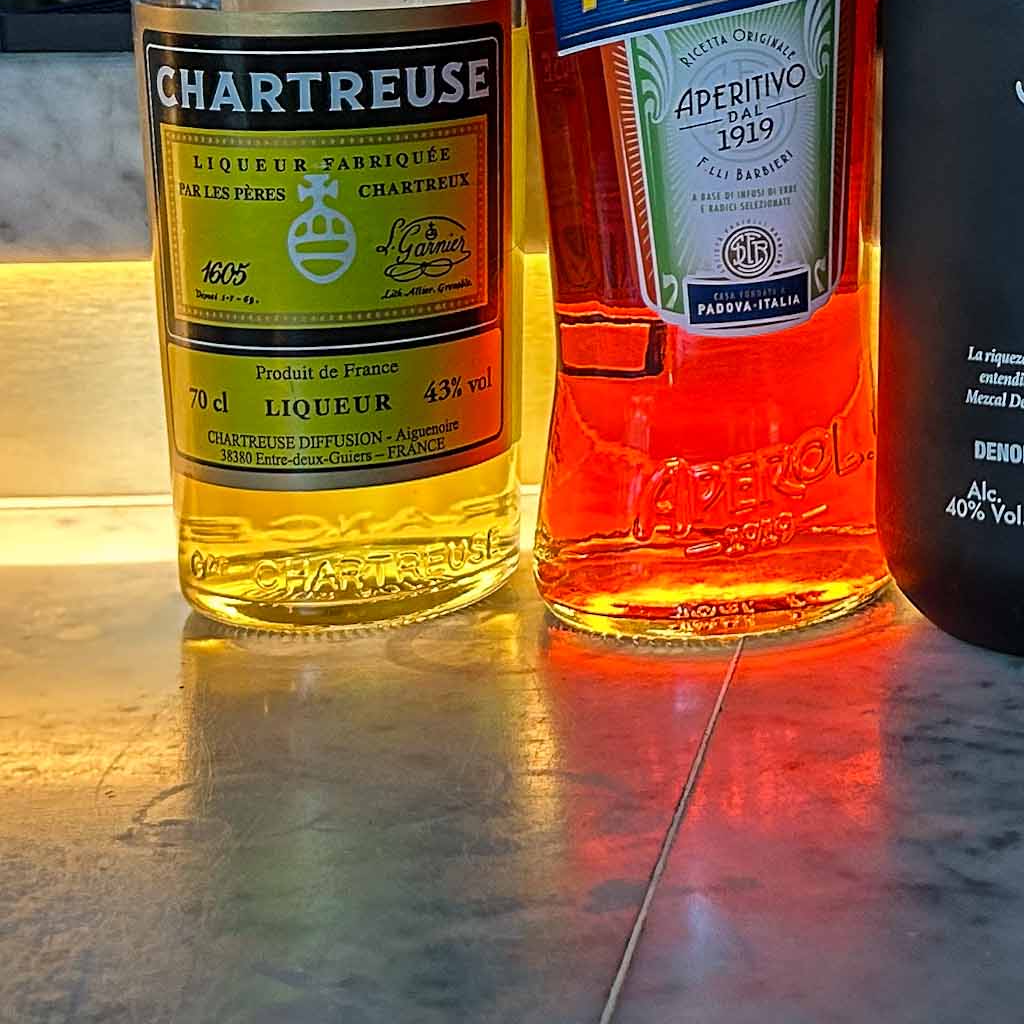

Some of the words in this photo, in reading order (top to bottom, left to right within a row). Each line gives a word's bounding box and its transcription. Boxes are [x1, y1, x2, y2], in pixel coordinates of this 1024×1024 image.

[680, 35, 728, 69] RICETTA
[732, 28, 796, 61] ORIGINALE
[156, 58, 490, 113] CHARTREUSE
[674, 63, 806, 120] APERITIVO
[728, 104, 763, 123] DAL
[717, 117, 774, 152] 1919
[193, 154, 308, 173] LIQUEUR
[323, 146, 451, 172] FABRIQUÉE
[736, 149, 793, 182] BARBIERI
[179, 182, 202, 198] PAR
[204, 185, 230, 201] LES
[233, 182, 286, 202] PÈRES
[358, 172, 470, 198] CHARTREUX
[201, 260, 250, 286] 1605
[967, 346, 983, 361] La
[256, 365, 314, 381] Produit
[319, 364, 338, 379] de
[344, 361, 399, 378] France
[423, 376, 463, 403] 43%
[467, 366, 493, 393] vol
[189, 387, 207, 409] 70
[213, 391, 228, 413] cl
[265, 394, 392, 419] LIQUEUR
[965, 388, 1006, 408] Mezcal
[207, 430, 295, 449] CHARTREUSE
[300, 431, 382, 450] DIFFUSION
[396, 418, 459, 442] Aiguenoire
[220, 449, 252, 464] 38380
[388, 437, 445, 459] FRANCE
[967, 480, 1002, 504] Alc.
[945, 496, 986, 521] 40%
